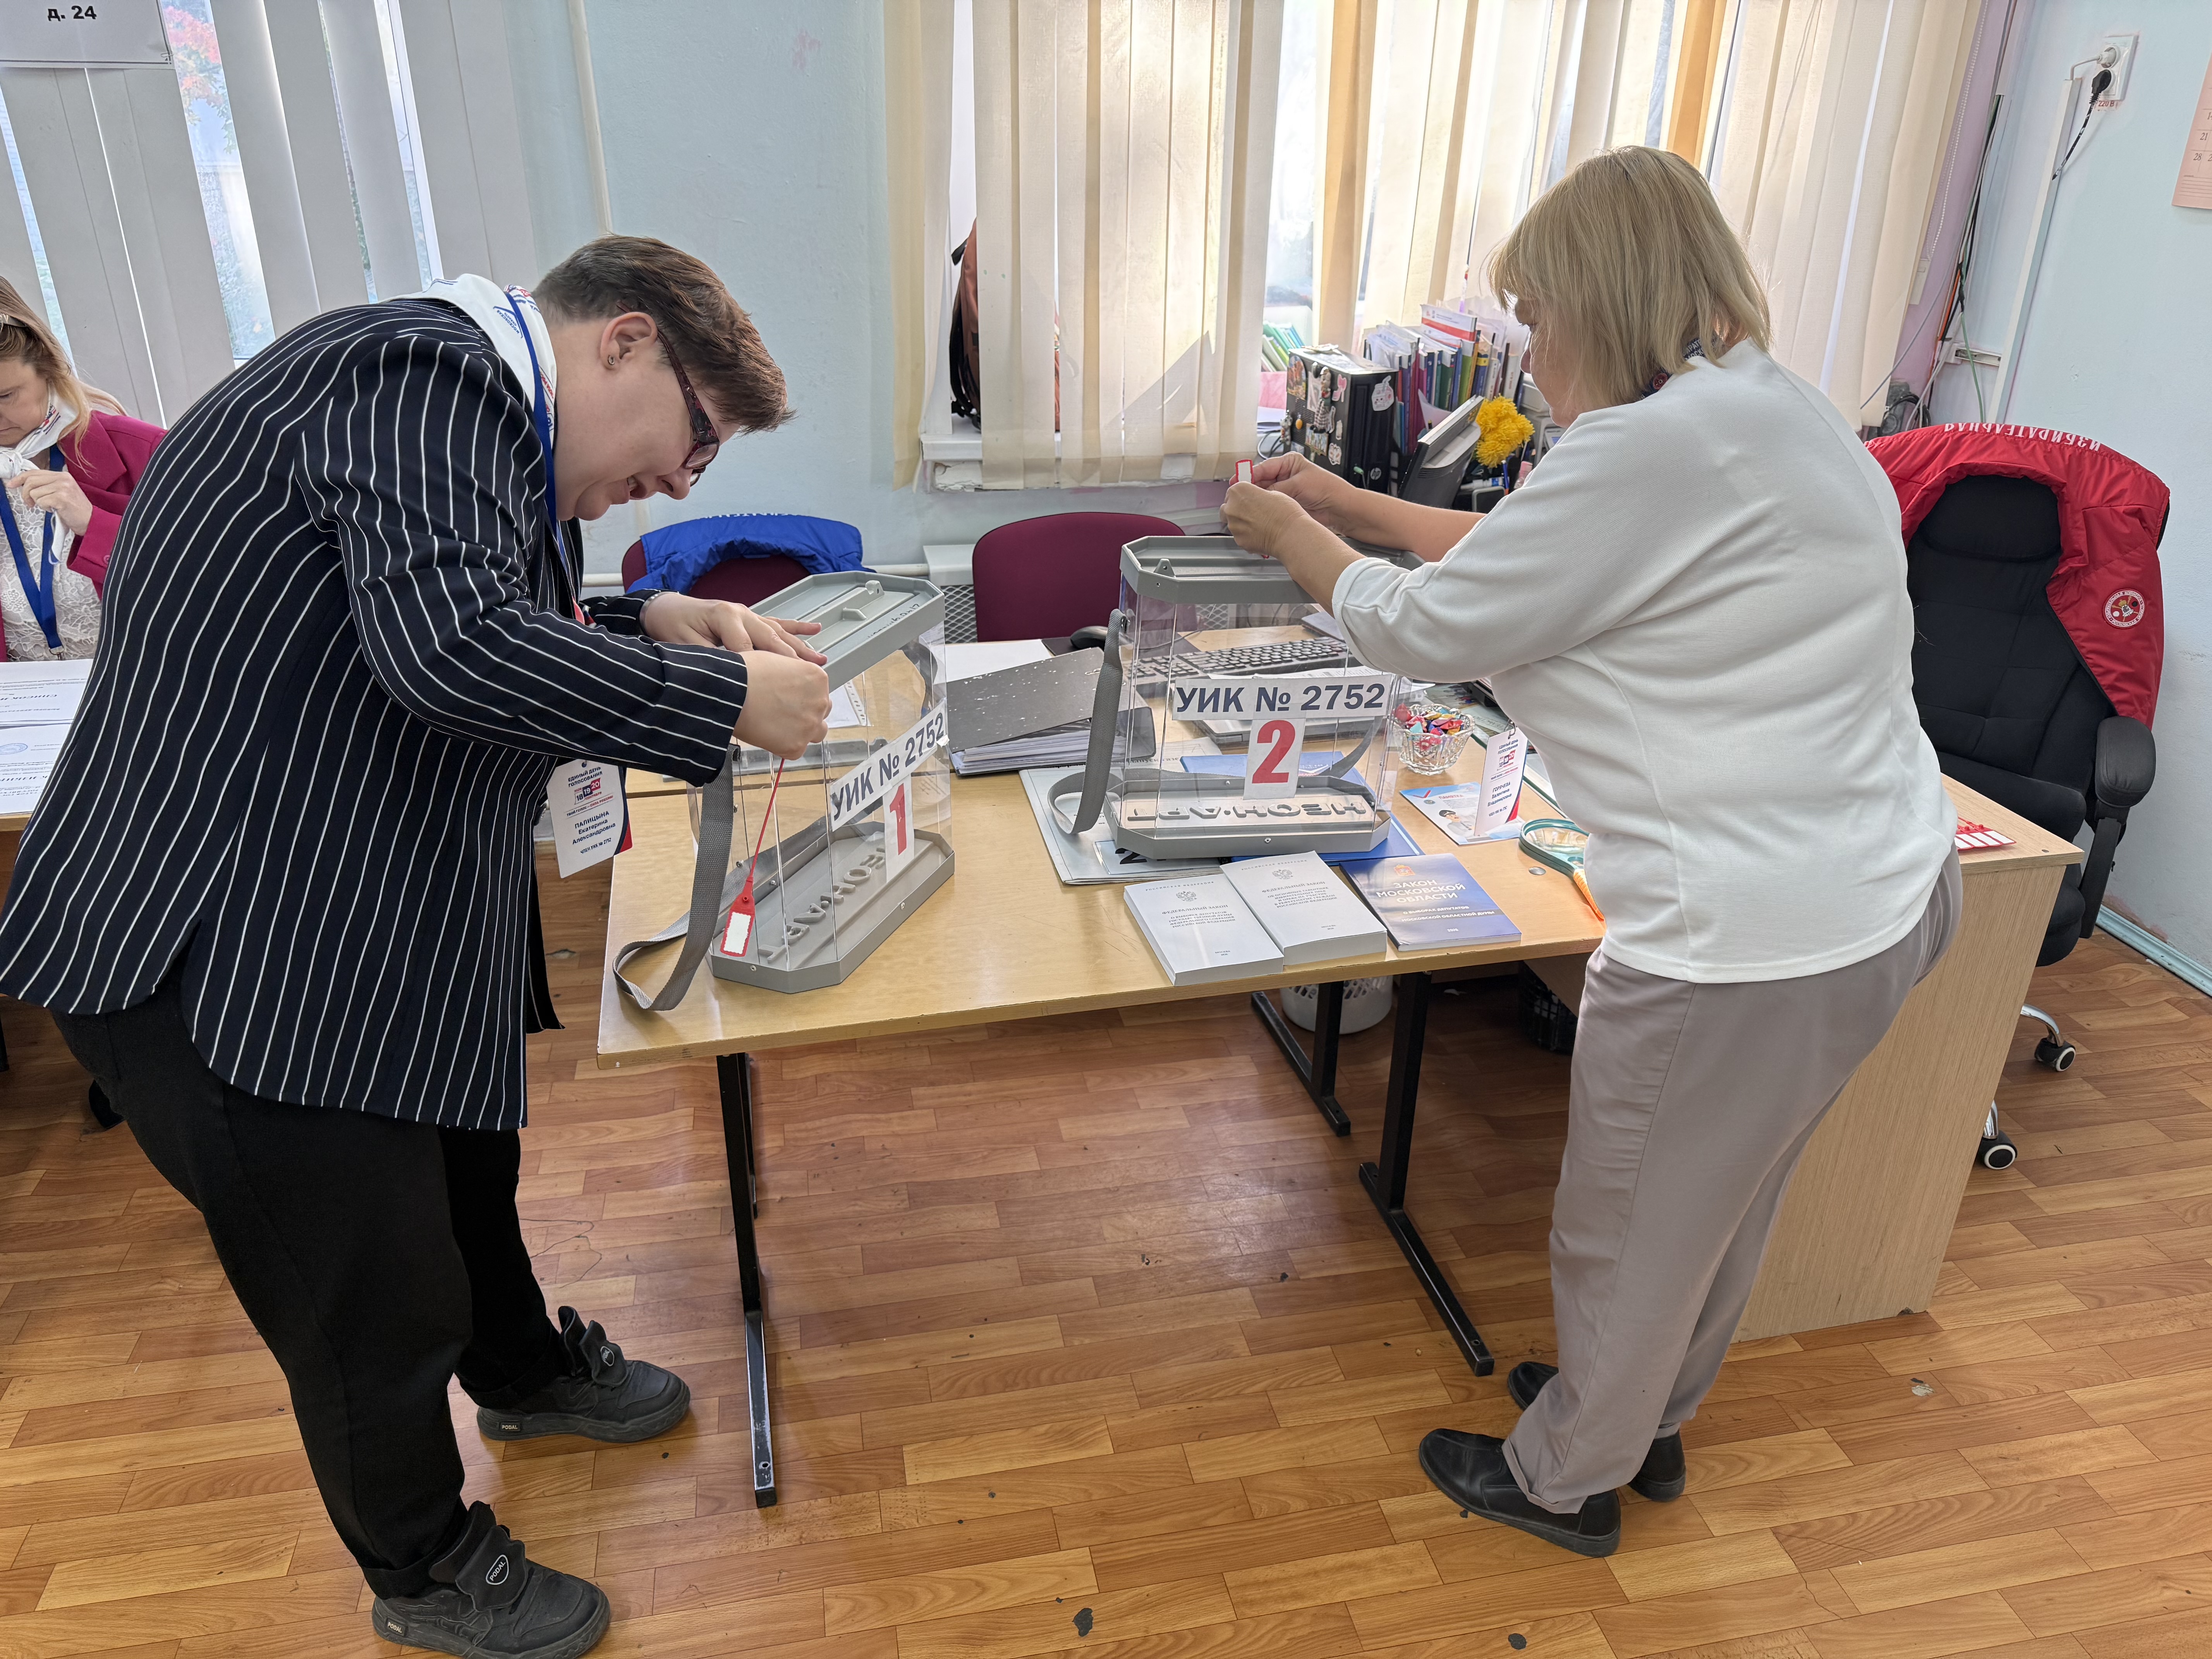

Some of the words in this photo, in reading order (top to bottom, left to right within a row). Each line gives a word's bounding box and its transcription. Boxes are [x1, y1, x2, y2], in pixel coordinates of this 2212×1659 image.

[48, 9, 65, 21] д.
[71, 5, 97, 19] 24
[1944, 422, 2100, 451] ИЗБИРАТЕЛЬНАЯ
[1176, 687, 1244, 713] УИК
[1256, 687, 1291, 711] №
[1301, 683, 1384, 711] 2752
[1252, 720, 1296, 784] 2
[568, 771, 588, 782] ЕДИНЫЙ
[589, 767, 601, 775] ДЕНЬ
[831, 766, 874, 821] УИК
[879, 753, 899, 787] №
[905, 713, 944, 768] 2752
[568, 771, 603, 787] ГОЛОСОВАНИЯ
[591, 781, 599, 789] 20
[575, 811, 609, 829] ПАЛИЦЫНА
[579, 819, 608, 834] Екатерина
[890, 783, 906, 855] 1
[573, 823, 615, 845] Александровна
[1262, 883, 1305, 893] ФЕДЕРАЛЬНЫЙ
[1376, 883, 1466, 898] МОСКОВСКОЙ
[1393, 879, 1437, 888] ЗАКОН
[1396, 893, 1458, 903] ОБЛАСТИ
[489, 1561, 506, 1582] PODAL
[388, 1622, 402, 1633] PODAL
